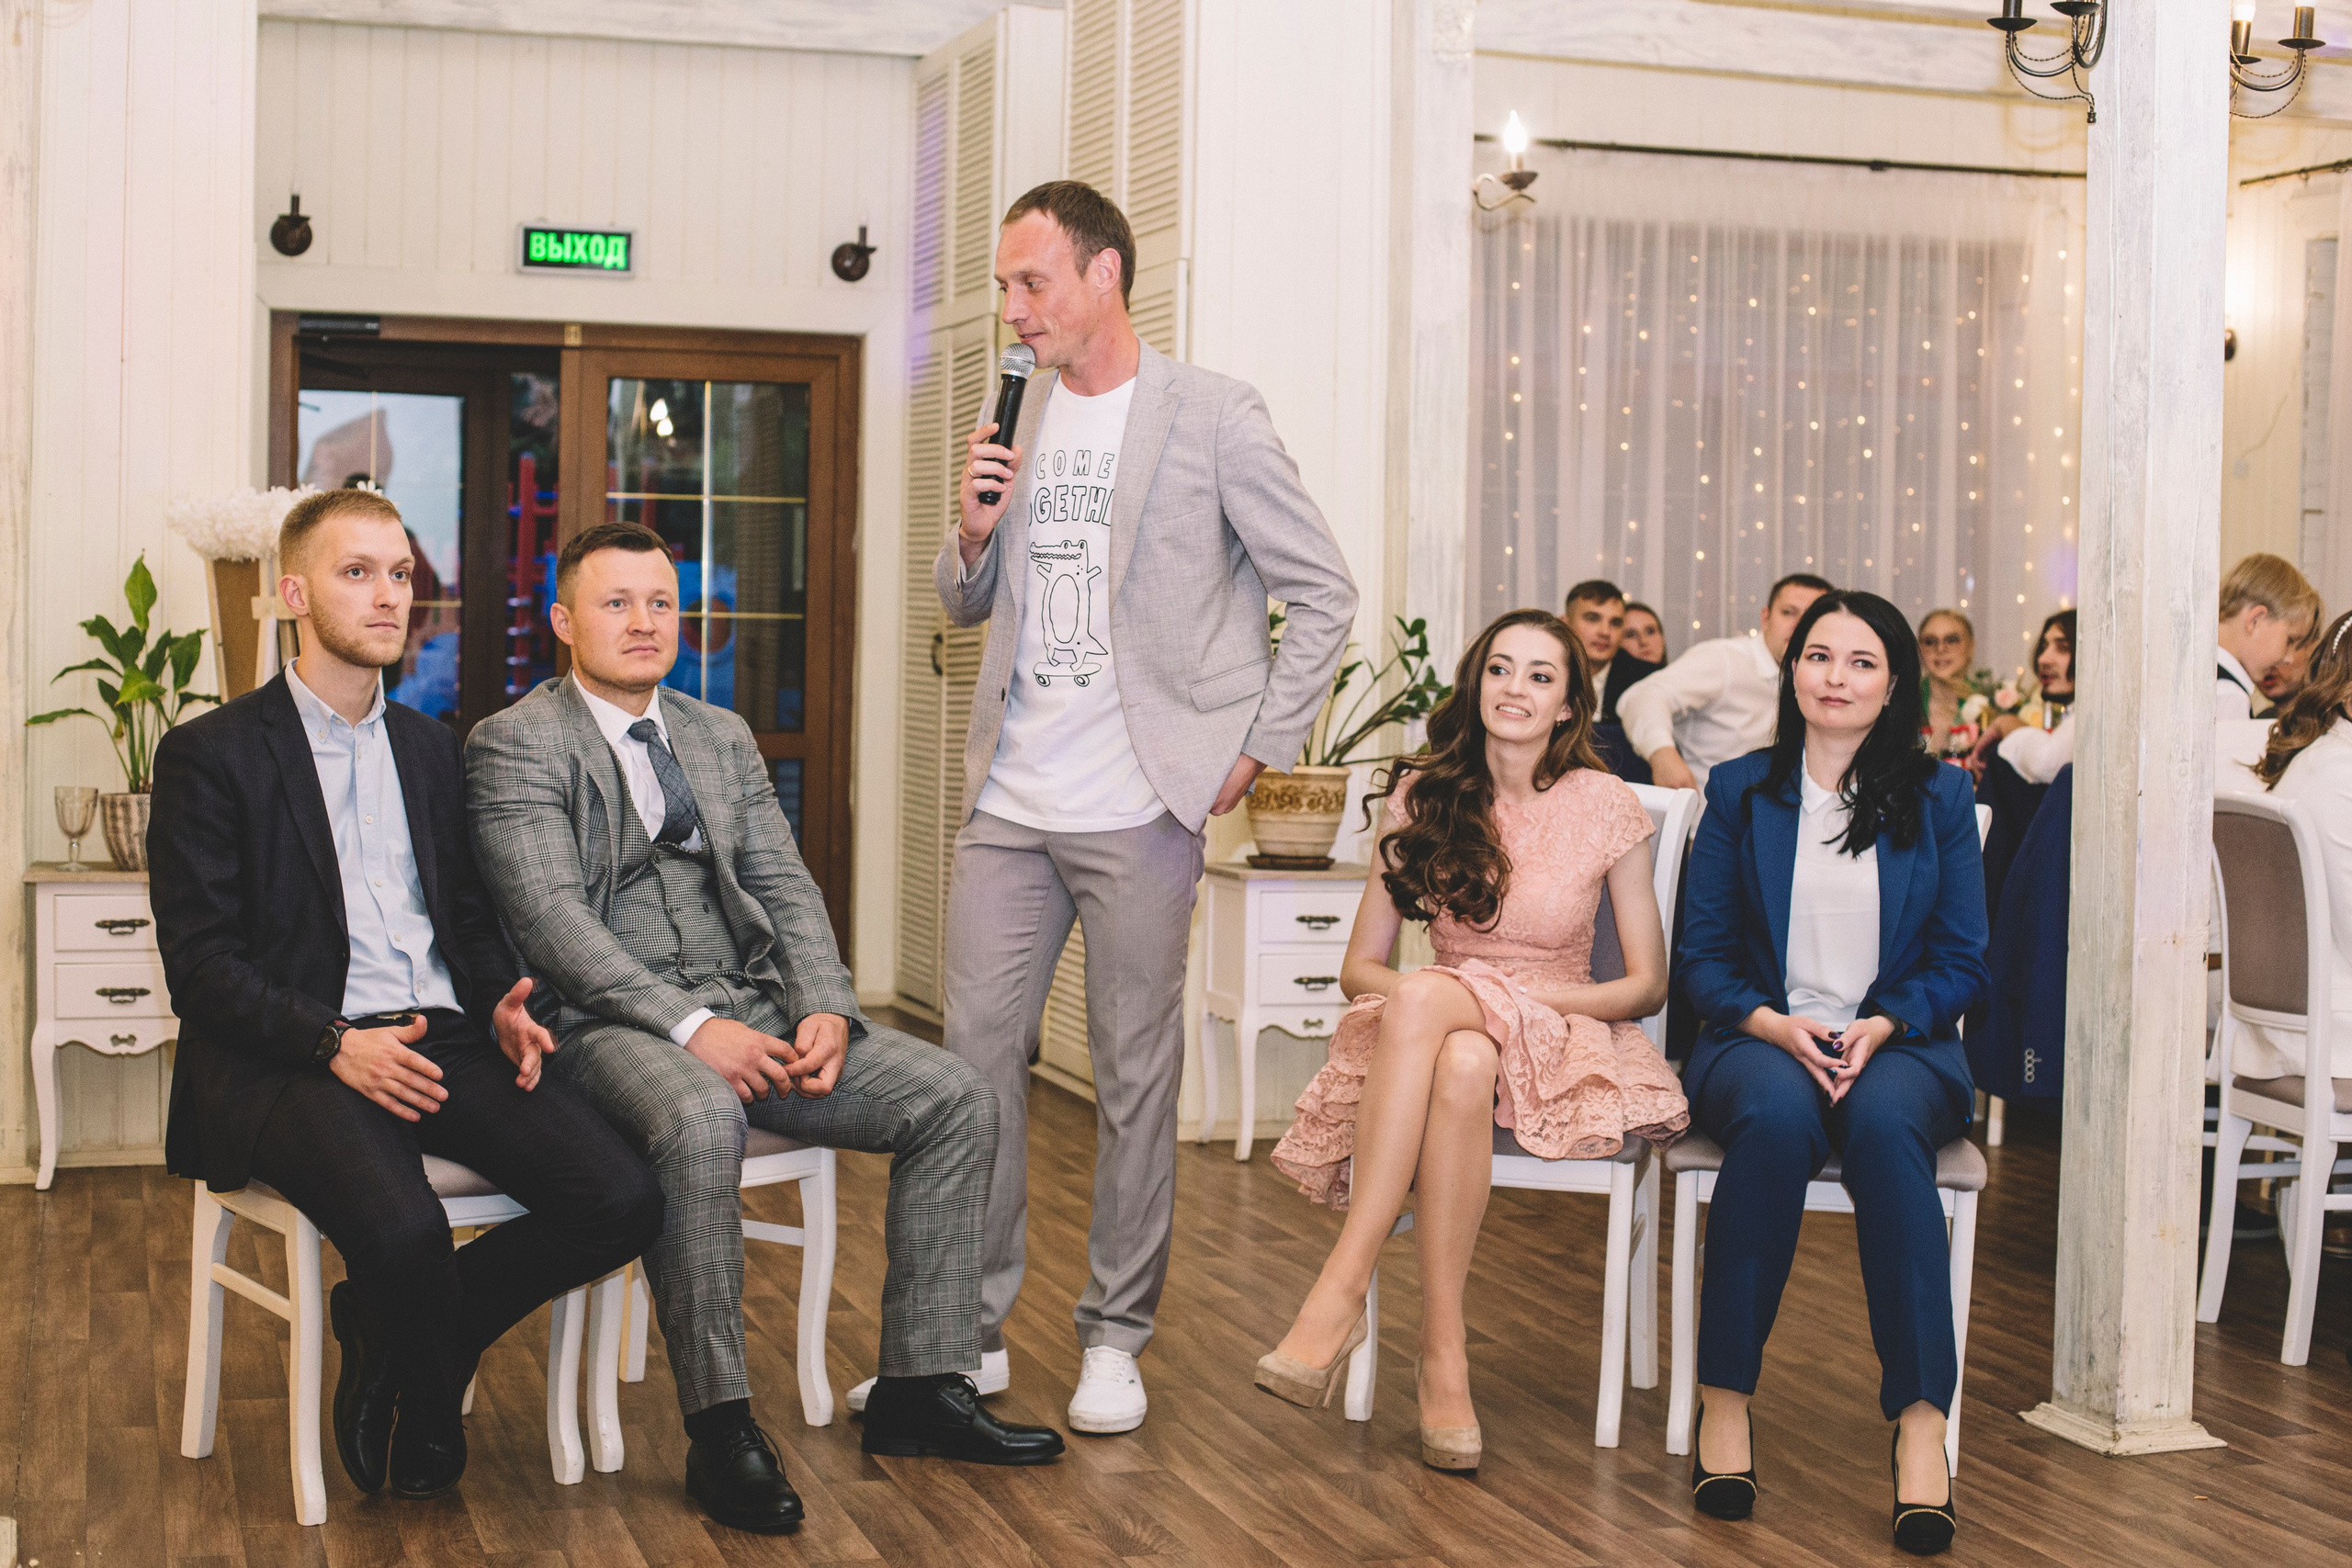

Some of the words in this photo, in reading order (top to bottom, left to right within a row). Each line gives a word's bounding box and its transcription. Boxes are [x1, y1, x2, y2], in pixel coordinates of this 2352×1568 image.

[529, 231, 627, 270] ВЫХОД
[1035, 449, 1114, 480] COME
[1029, 484, 1114, 526] GETH
